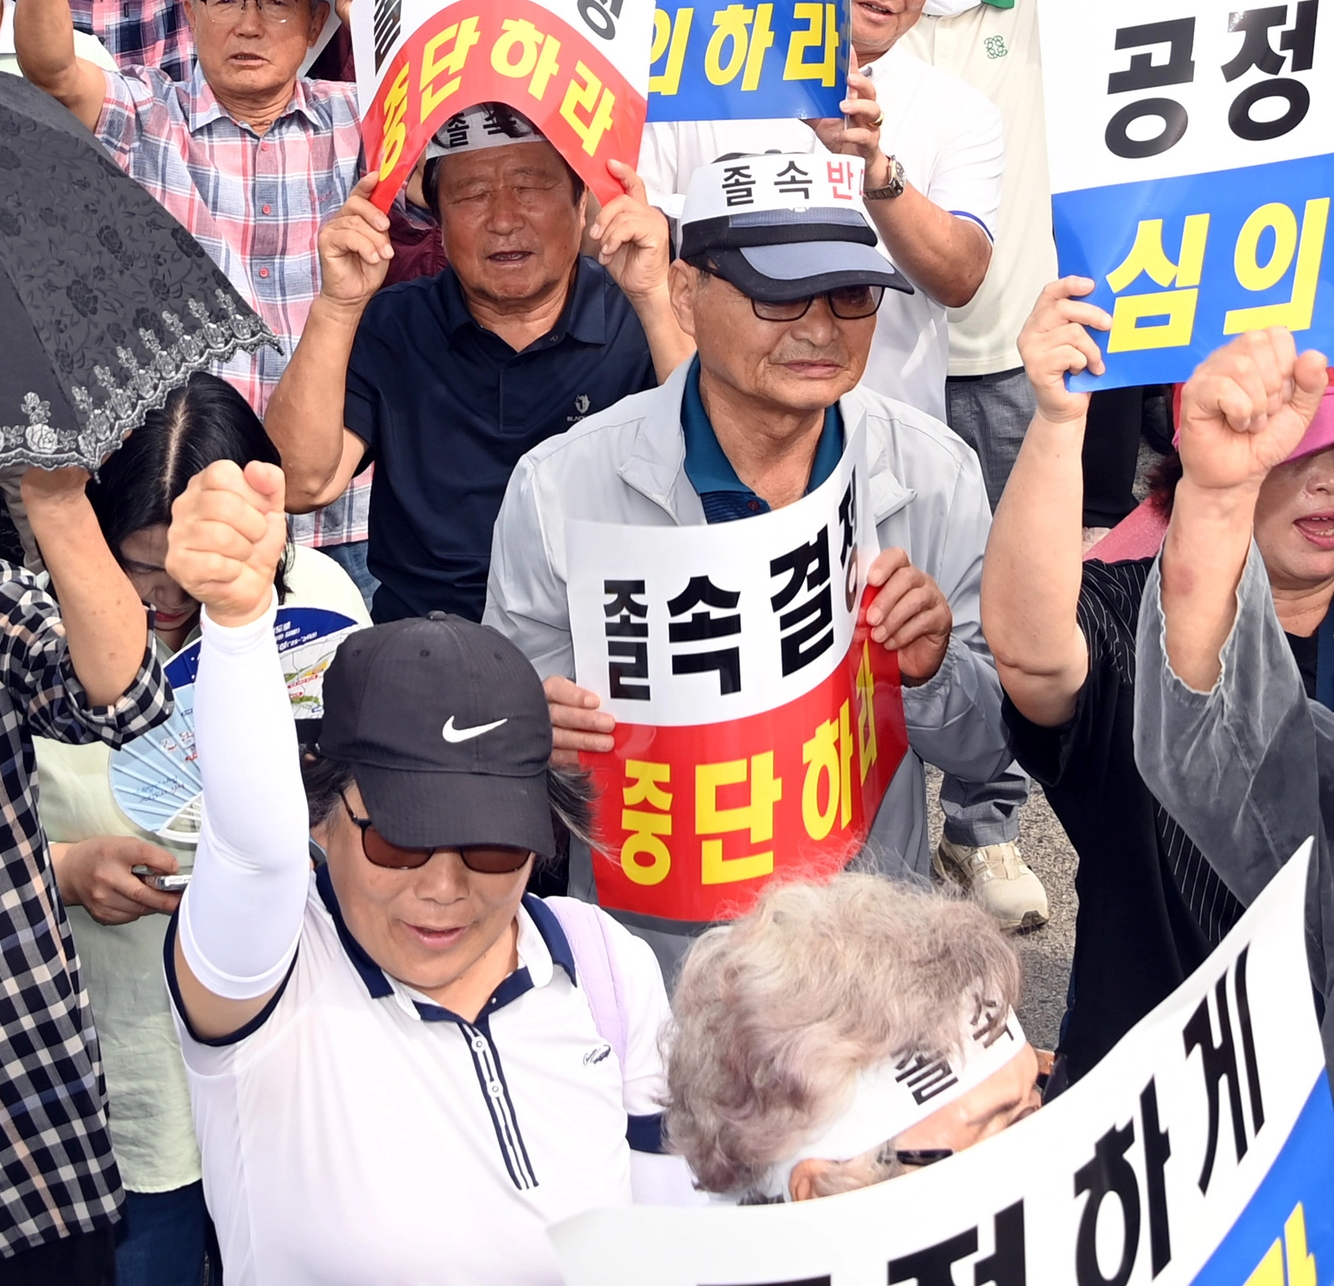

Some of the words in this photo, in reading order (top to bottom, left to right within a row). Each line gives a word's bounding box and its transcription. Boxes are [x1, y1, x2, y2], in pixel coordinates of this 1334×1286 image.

[378, 12, 616, 184] 중단하라
[649, 0, 842, 97] 의하라
[720, 154, 863, 208] 졸속반
[603, 461, 861, 702] 졸속결정
[619, 639, 879, 887] 중단하라
[697, 942, 1267, 1286] 하게
